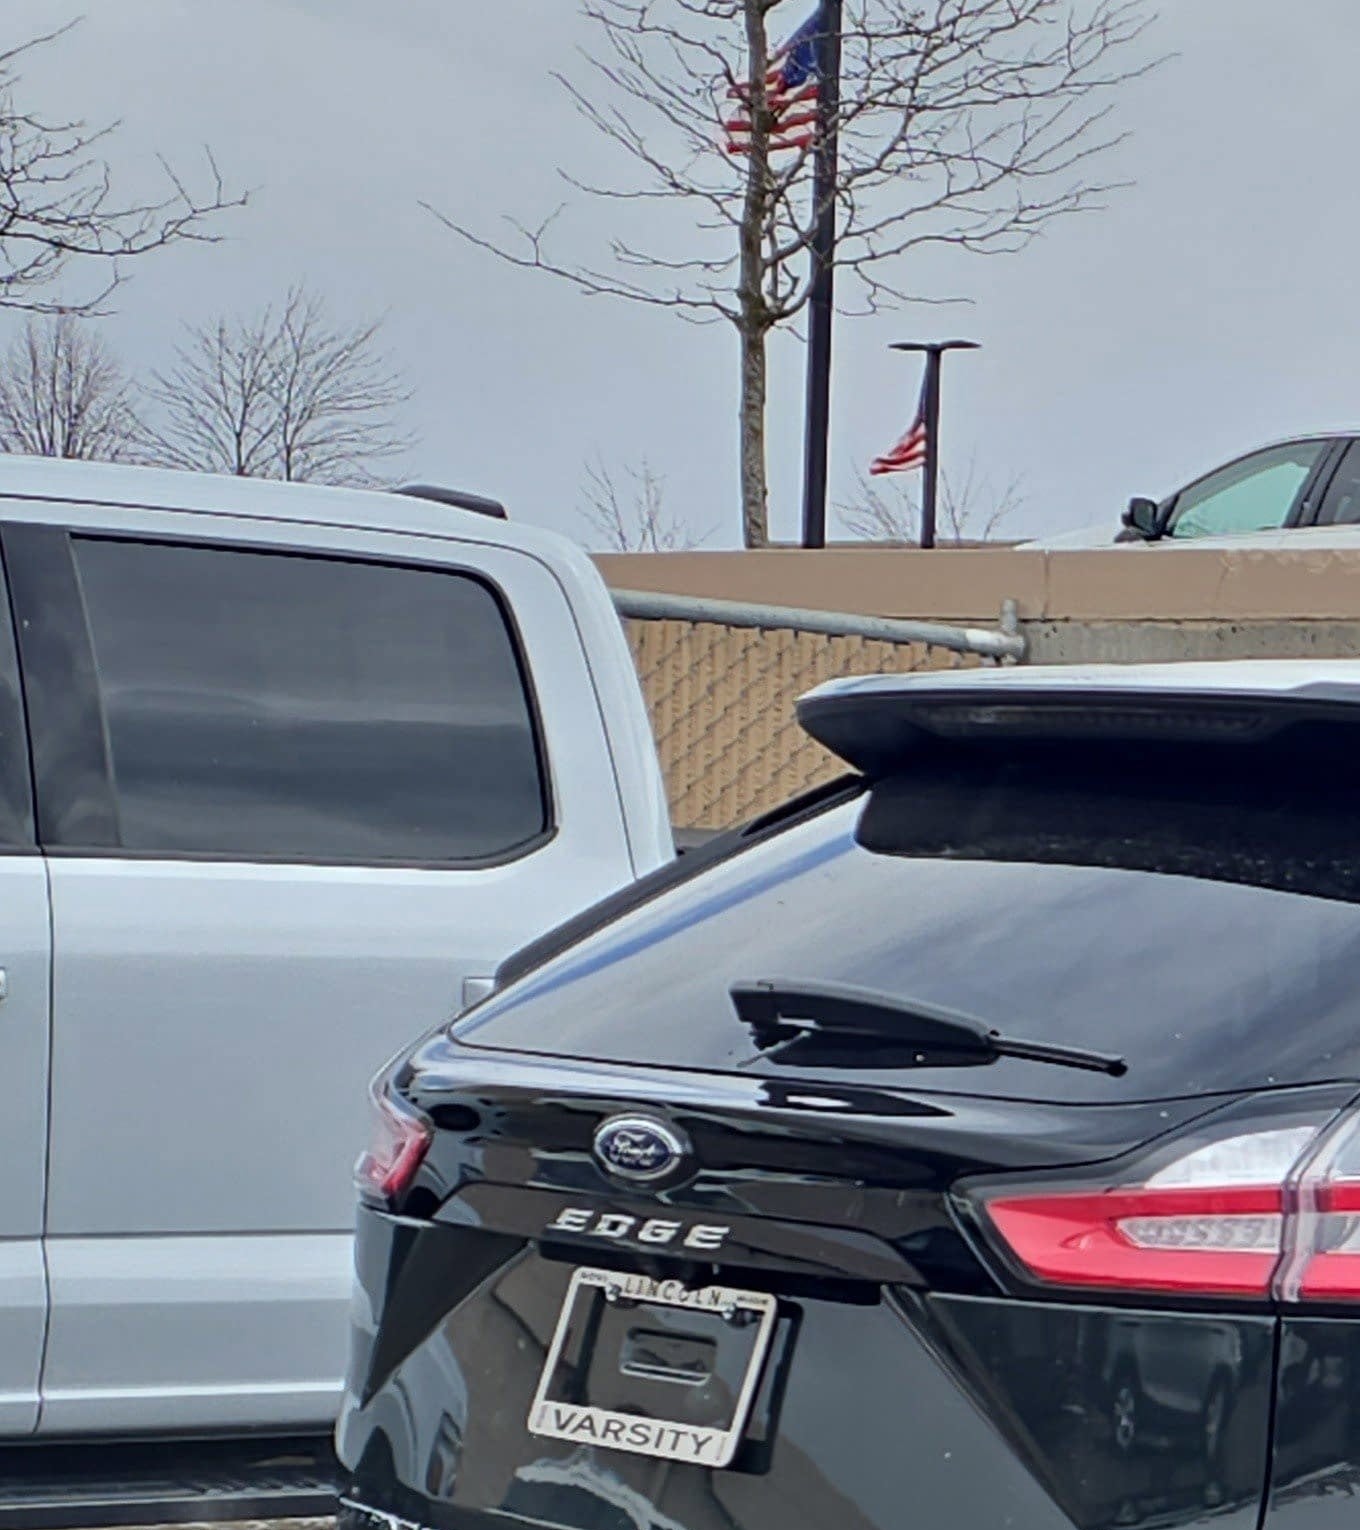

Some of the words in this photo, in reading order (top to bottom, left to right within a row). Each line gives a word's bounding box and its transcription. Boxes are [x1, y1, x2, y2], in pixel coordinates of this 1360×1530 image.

[546, 1207, 730, 1250] EDGE
[624, 1277, 722, 1307] LINCOLN
[553, 1408, 713, 1456] VARSITY
